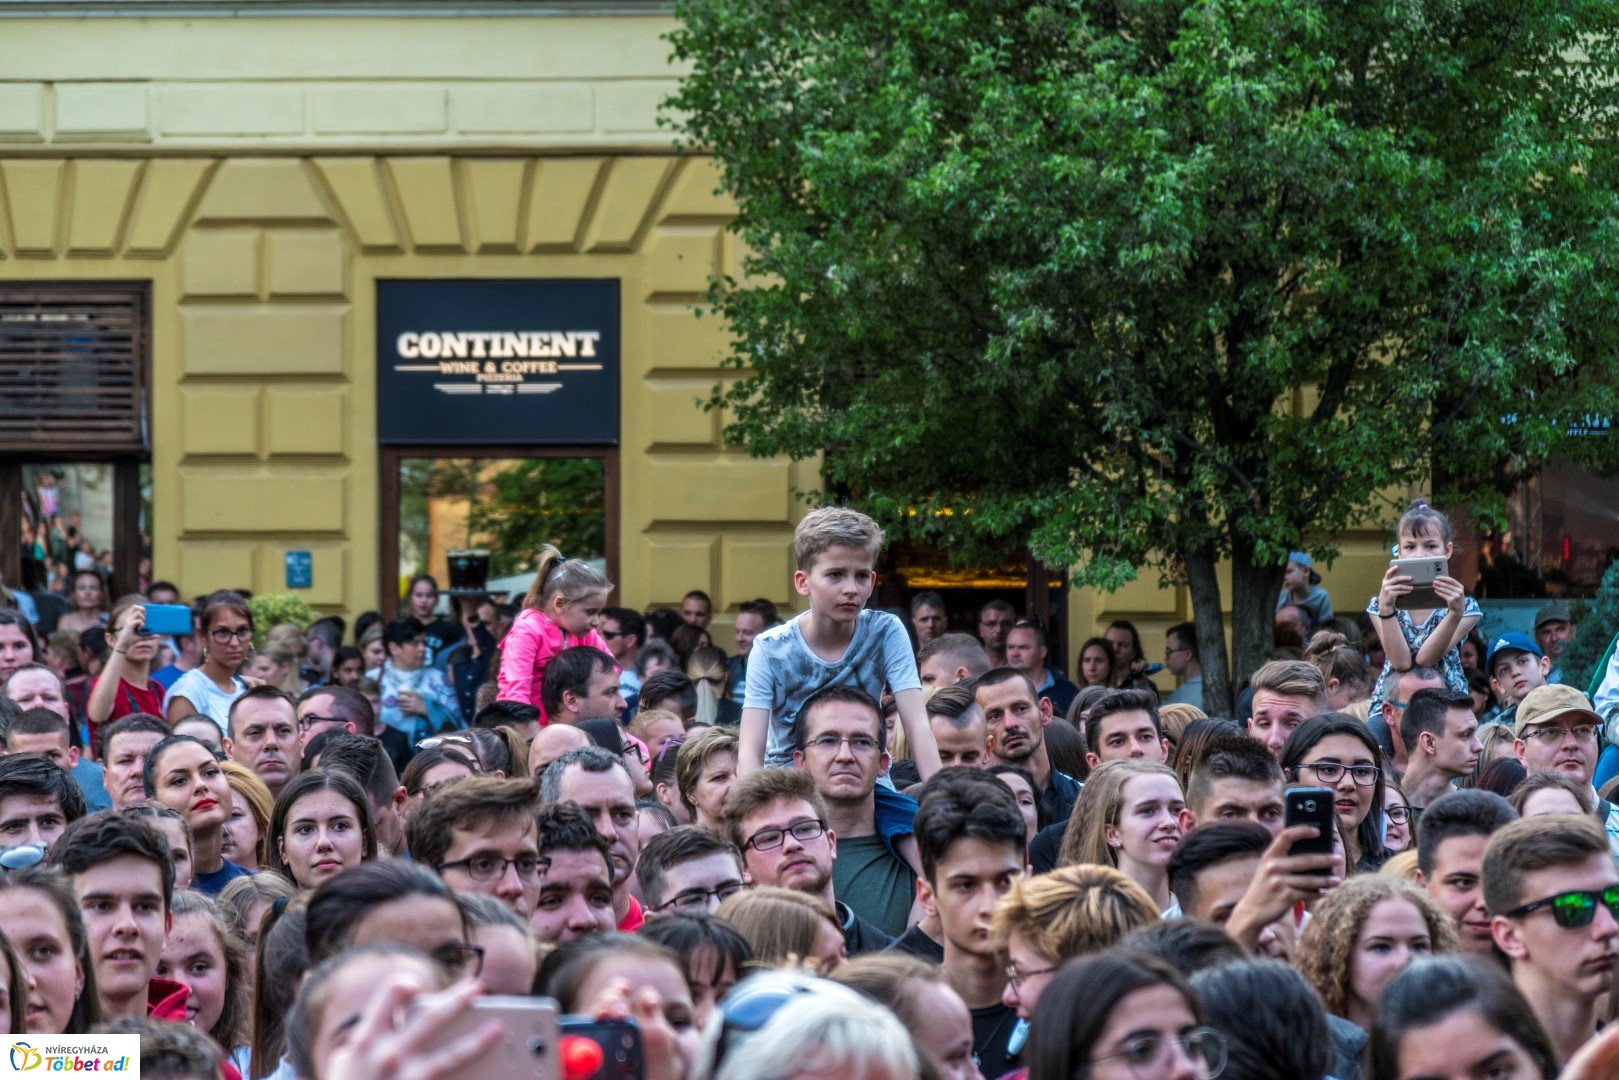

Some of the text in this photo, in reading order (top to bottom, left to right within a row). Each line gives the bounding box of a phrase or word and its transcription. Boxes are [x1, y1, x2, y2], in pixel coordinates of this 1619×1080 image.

[396, 331, 601, 359] CONTINENT
[440, 361, 558, 374] WINE & COFFEE
[475, 373, 524, 383] PIZZERIA
